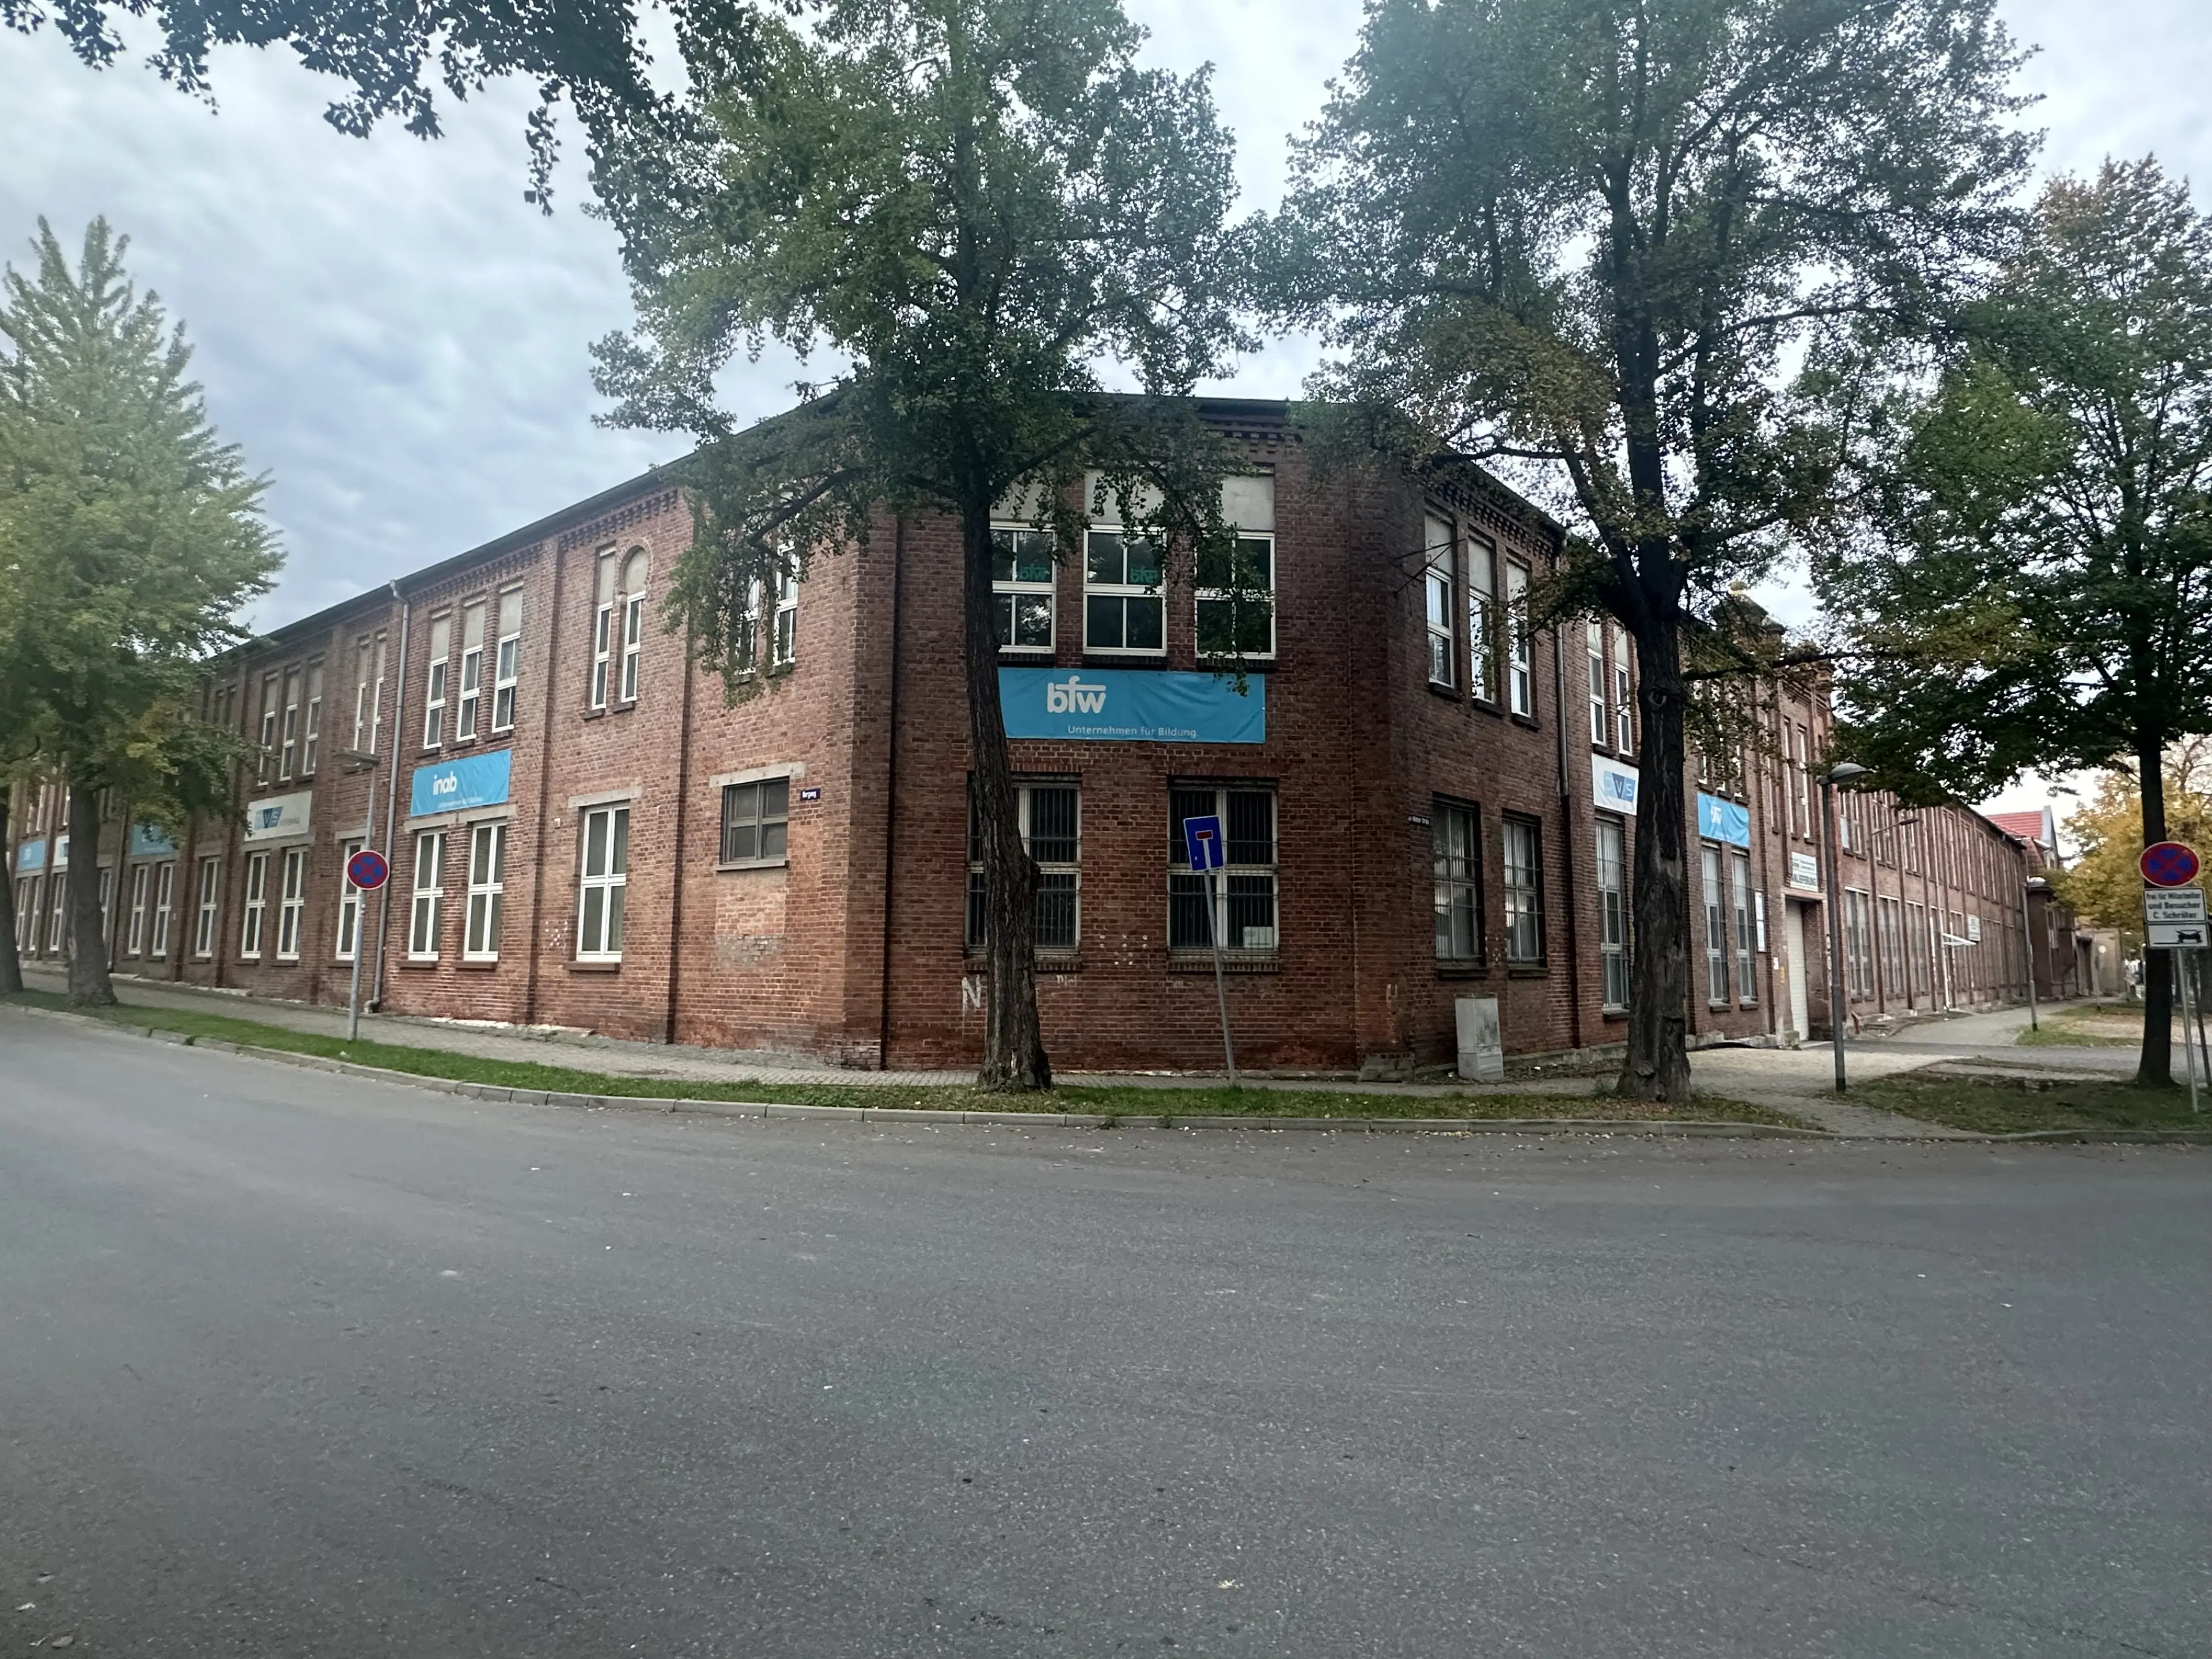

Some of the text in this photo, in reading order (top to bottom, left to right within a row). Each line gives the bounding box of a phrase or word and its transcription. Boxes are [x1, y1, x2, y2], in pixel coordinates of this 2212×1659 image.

[1047, 675, 1107, 713] bfw
[1067, 725, 1196, 738] Unternehmen für Bildung
[433, 770, 457, 795] inab
